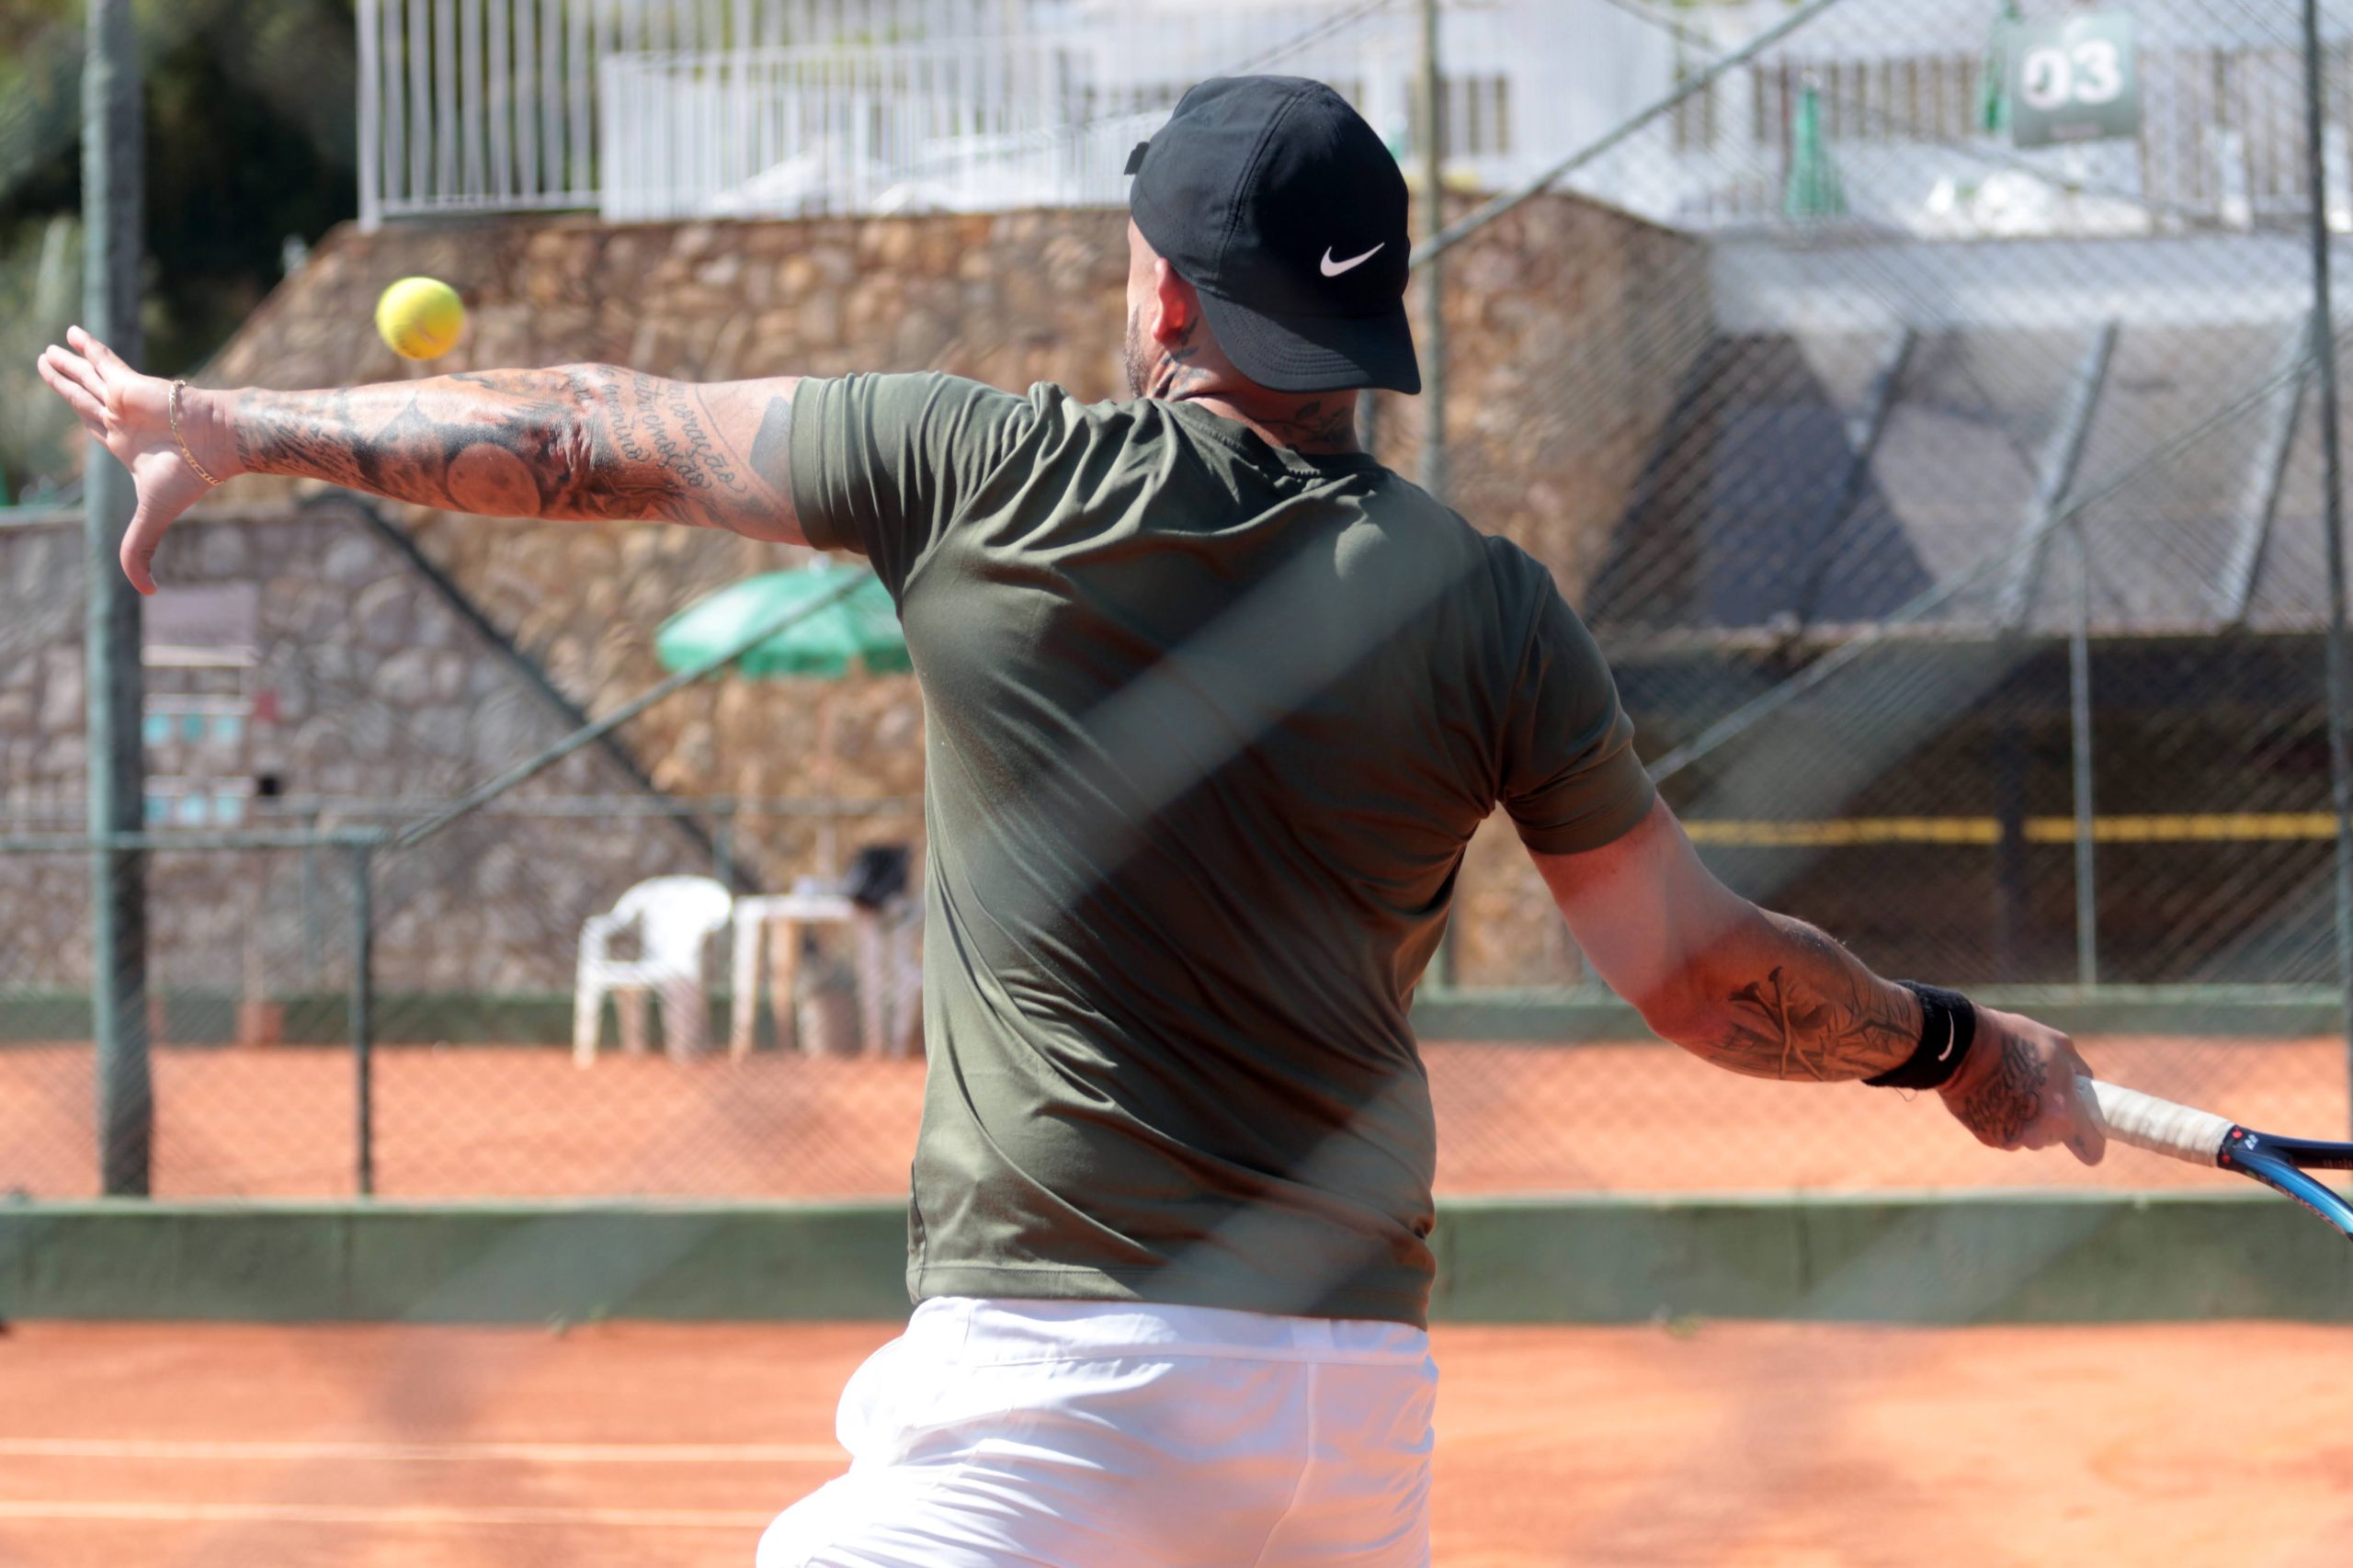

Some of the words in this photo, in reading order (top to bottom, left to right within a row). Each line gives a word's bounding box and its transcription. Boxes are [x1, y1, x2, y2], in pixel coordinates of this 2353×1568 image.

[2024, 40, 2121, 108] 03
[642, 414, 712, 489] emoção
[669, 403, 747, 493] coração
